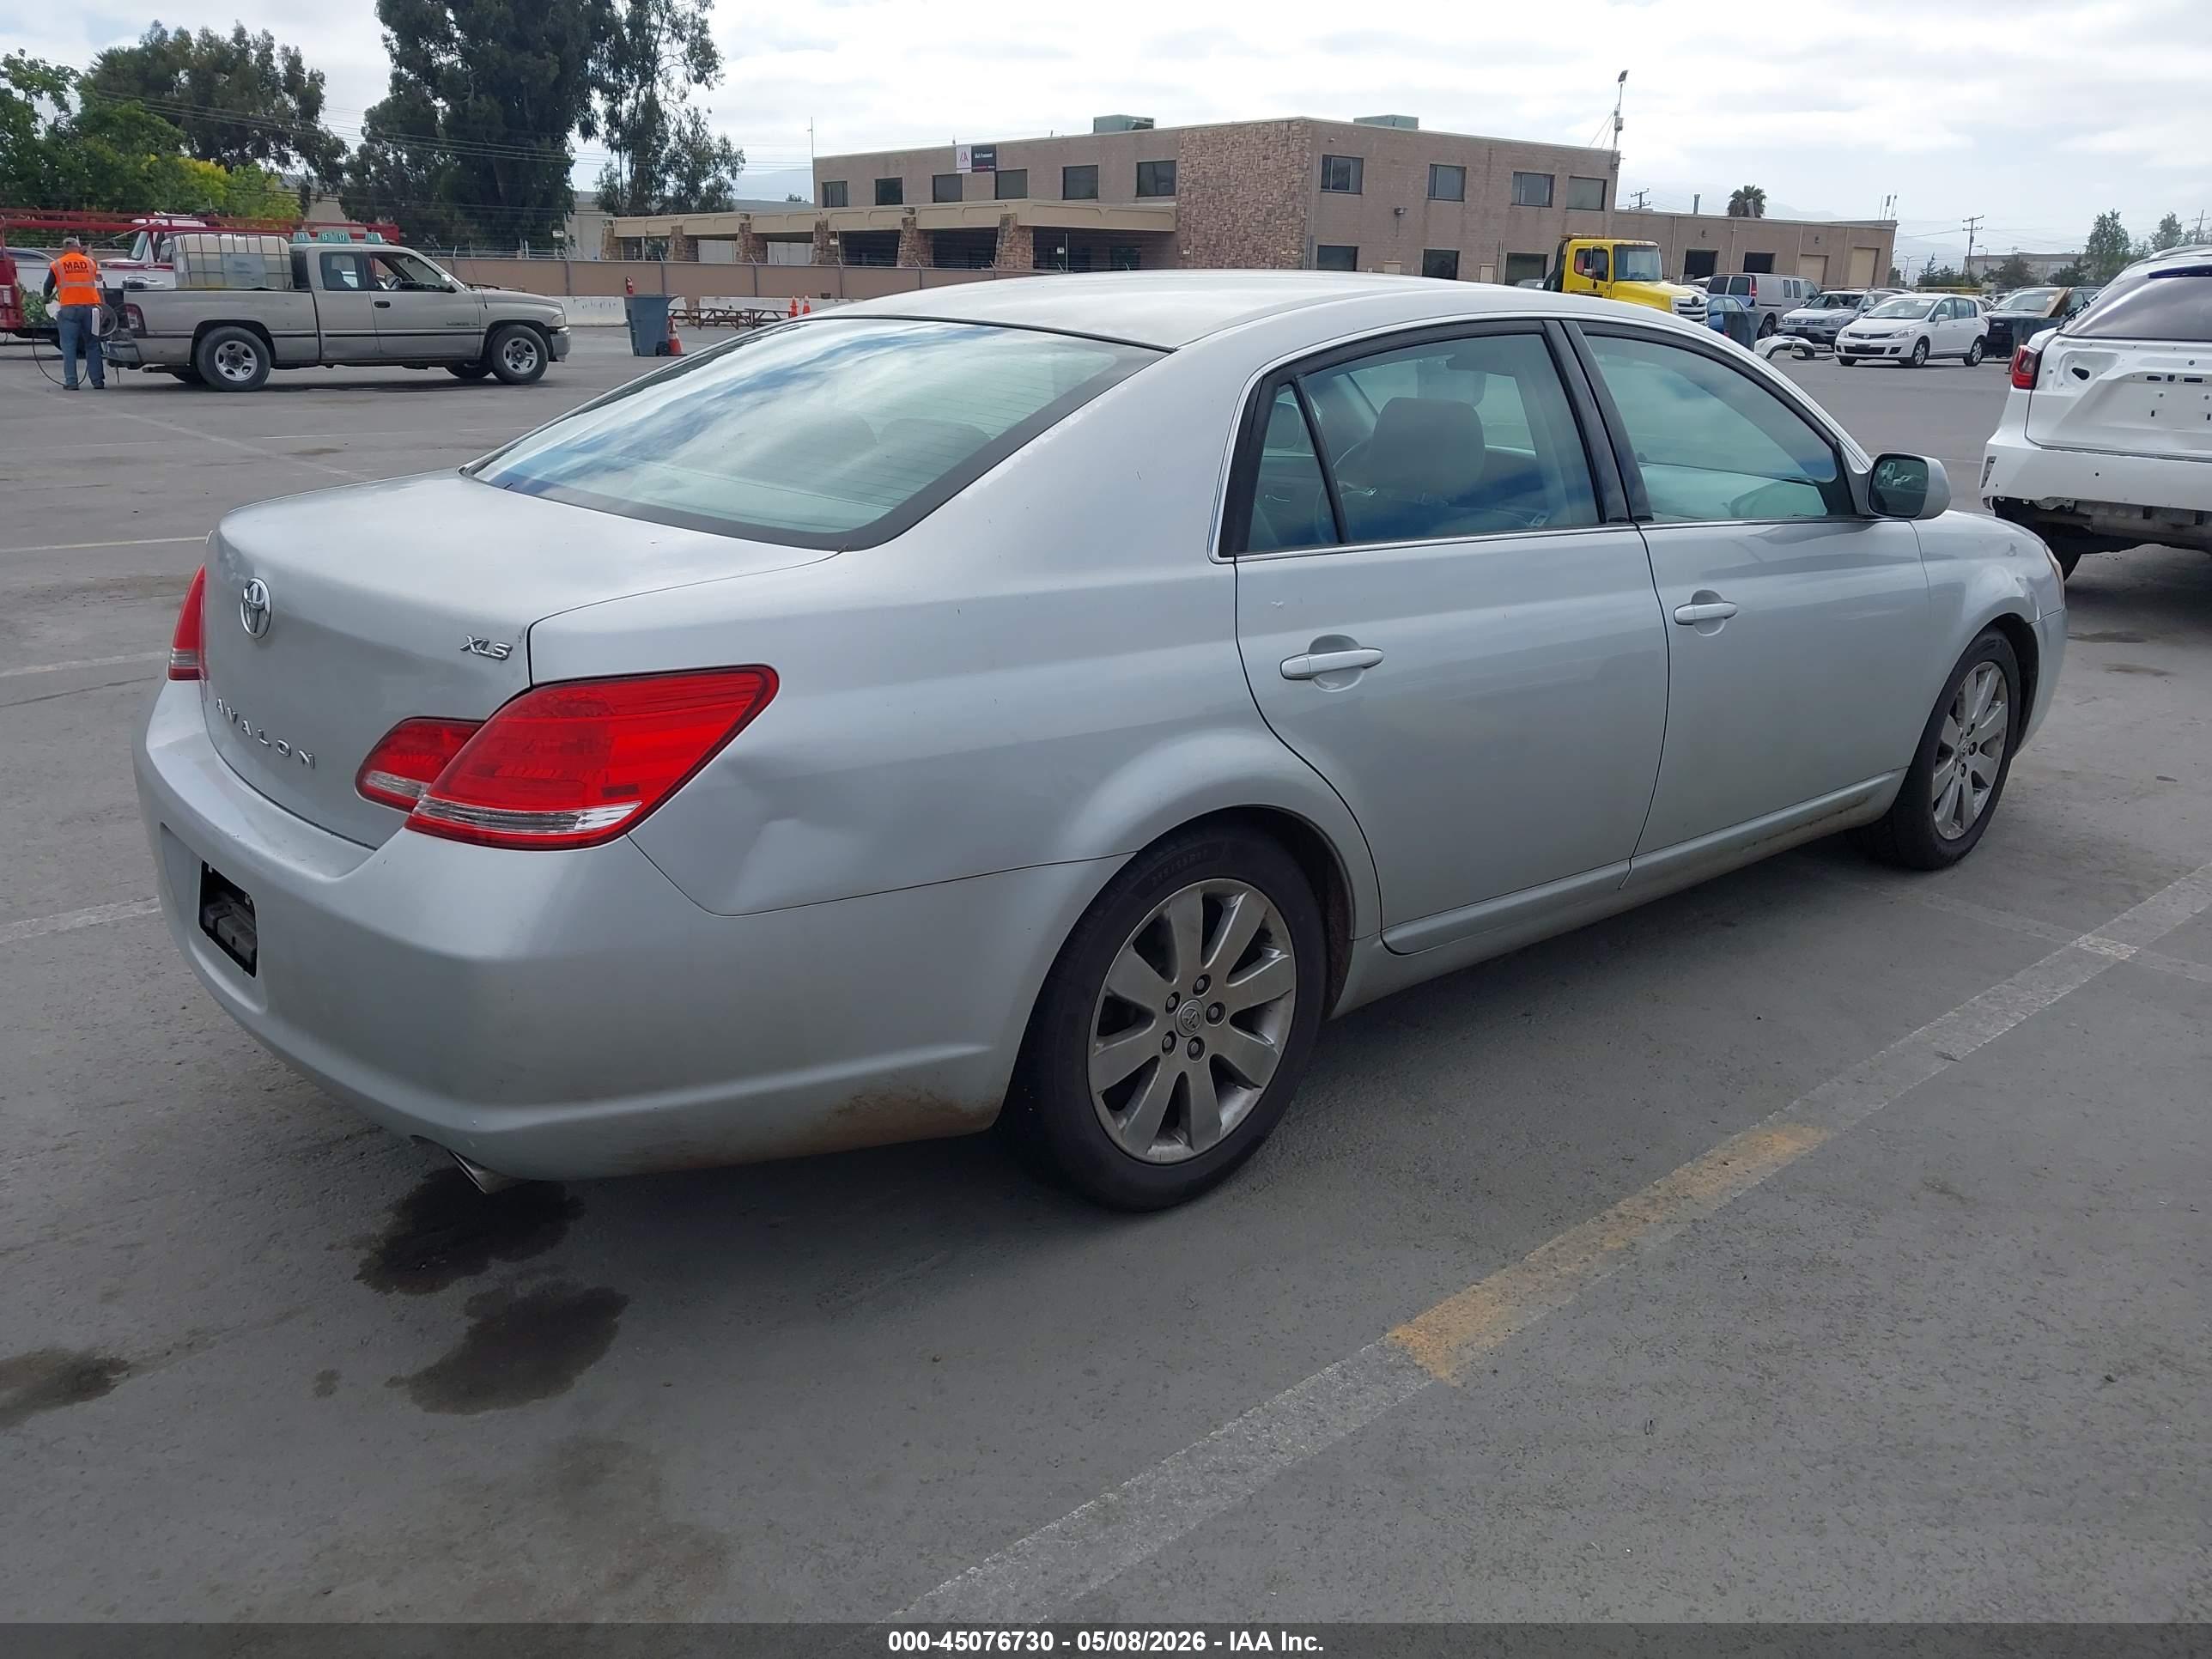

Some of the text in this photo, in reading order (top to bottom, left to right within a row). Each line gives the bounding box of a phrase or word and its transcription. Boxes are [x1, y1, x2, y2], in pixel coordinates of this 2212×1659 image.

[63, 261, 88, 270] MAD
[459, 635, 513, 660] XLS
[216, 698, 315, 769] AVALON
